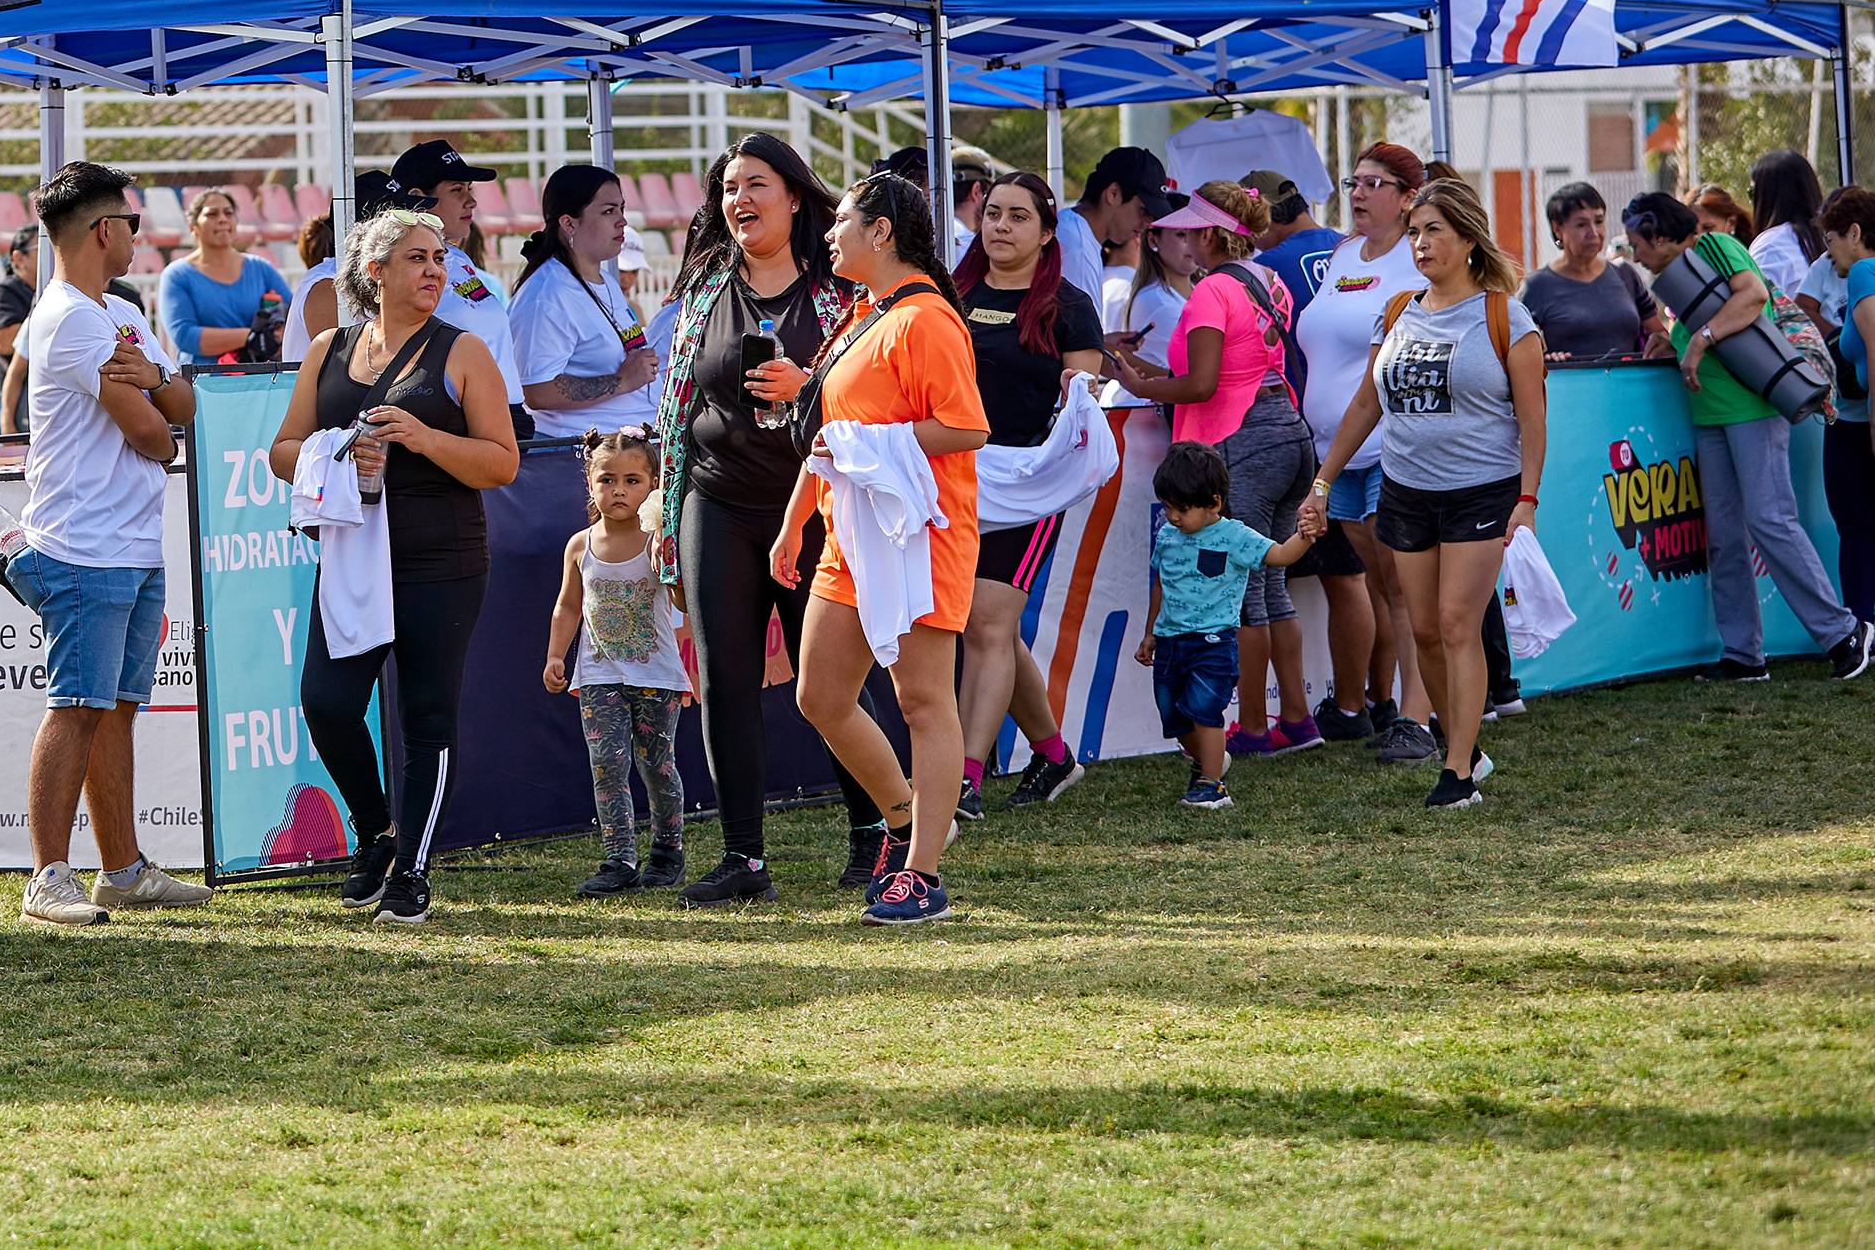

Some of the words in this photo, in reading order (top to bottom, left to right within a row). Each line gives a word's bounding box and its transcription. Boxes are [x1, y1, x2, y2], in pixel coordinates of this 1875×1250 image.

[974, 312, 1010, 322] MANGO
[224, 448, 287, 509] ZO
[1654, 517, 1707, 561] MOTIV
[273, 607, 298, 666] Y
